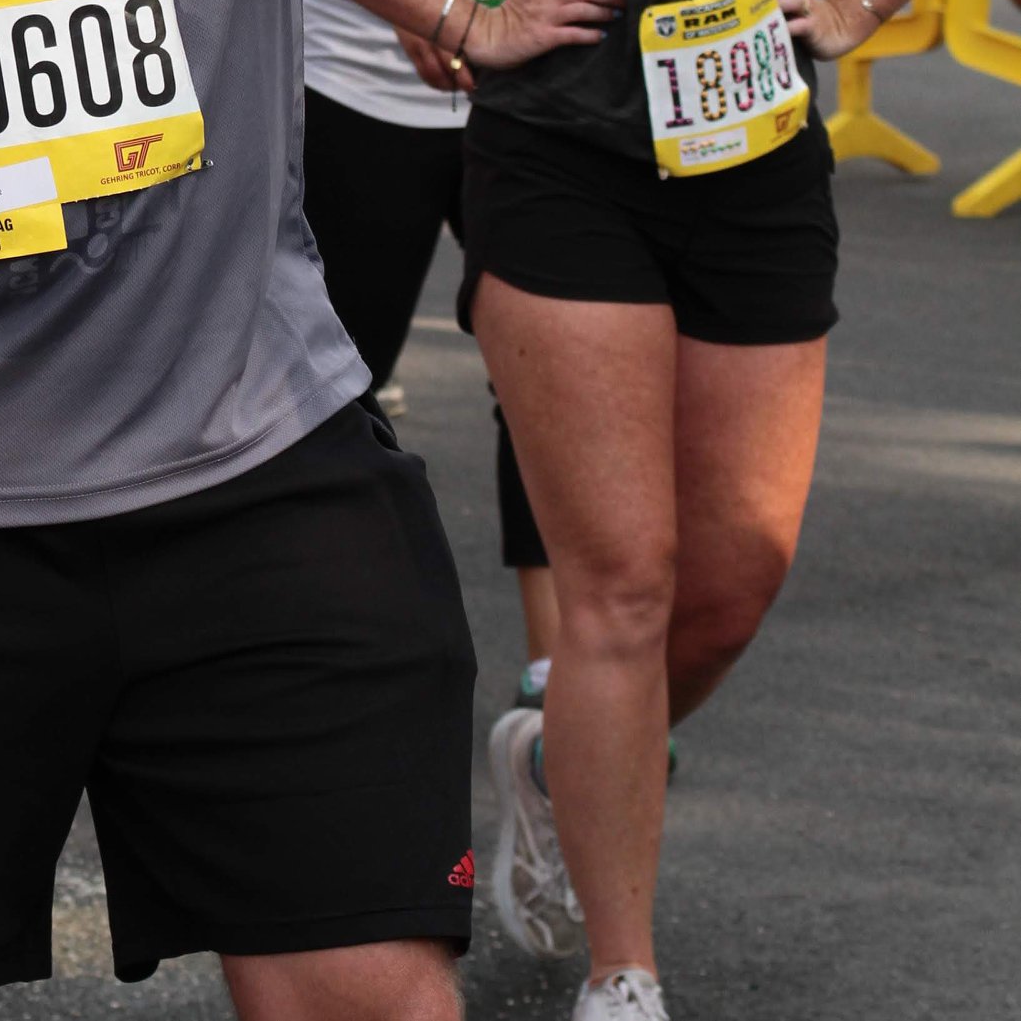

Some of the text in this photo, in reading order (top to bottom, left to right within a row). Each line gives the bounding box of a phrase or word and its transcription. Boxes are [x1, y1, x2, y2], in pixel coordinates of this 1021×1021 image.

[657, 19, 792, 129] 18985
[114, 133, 164, 172] GT
[101, 172, 134, 185] GEHRING
